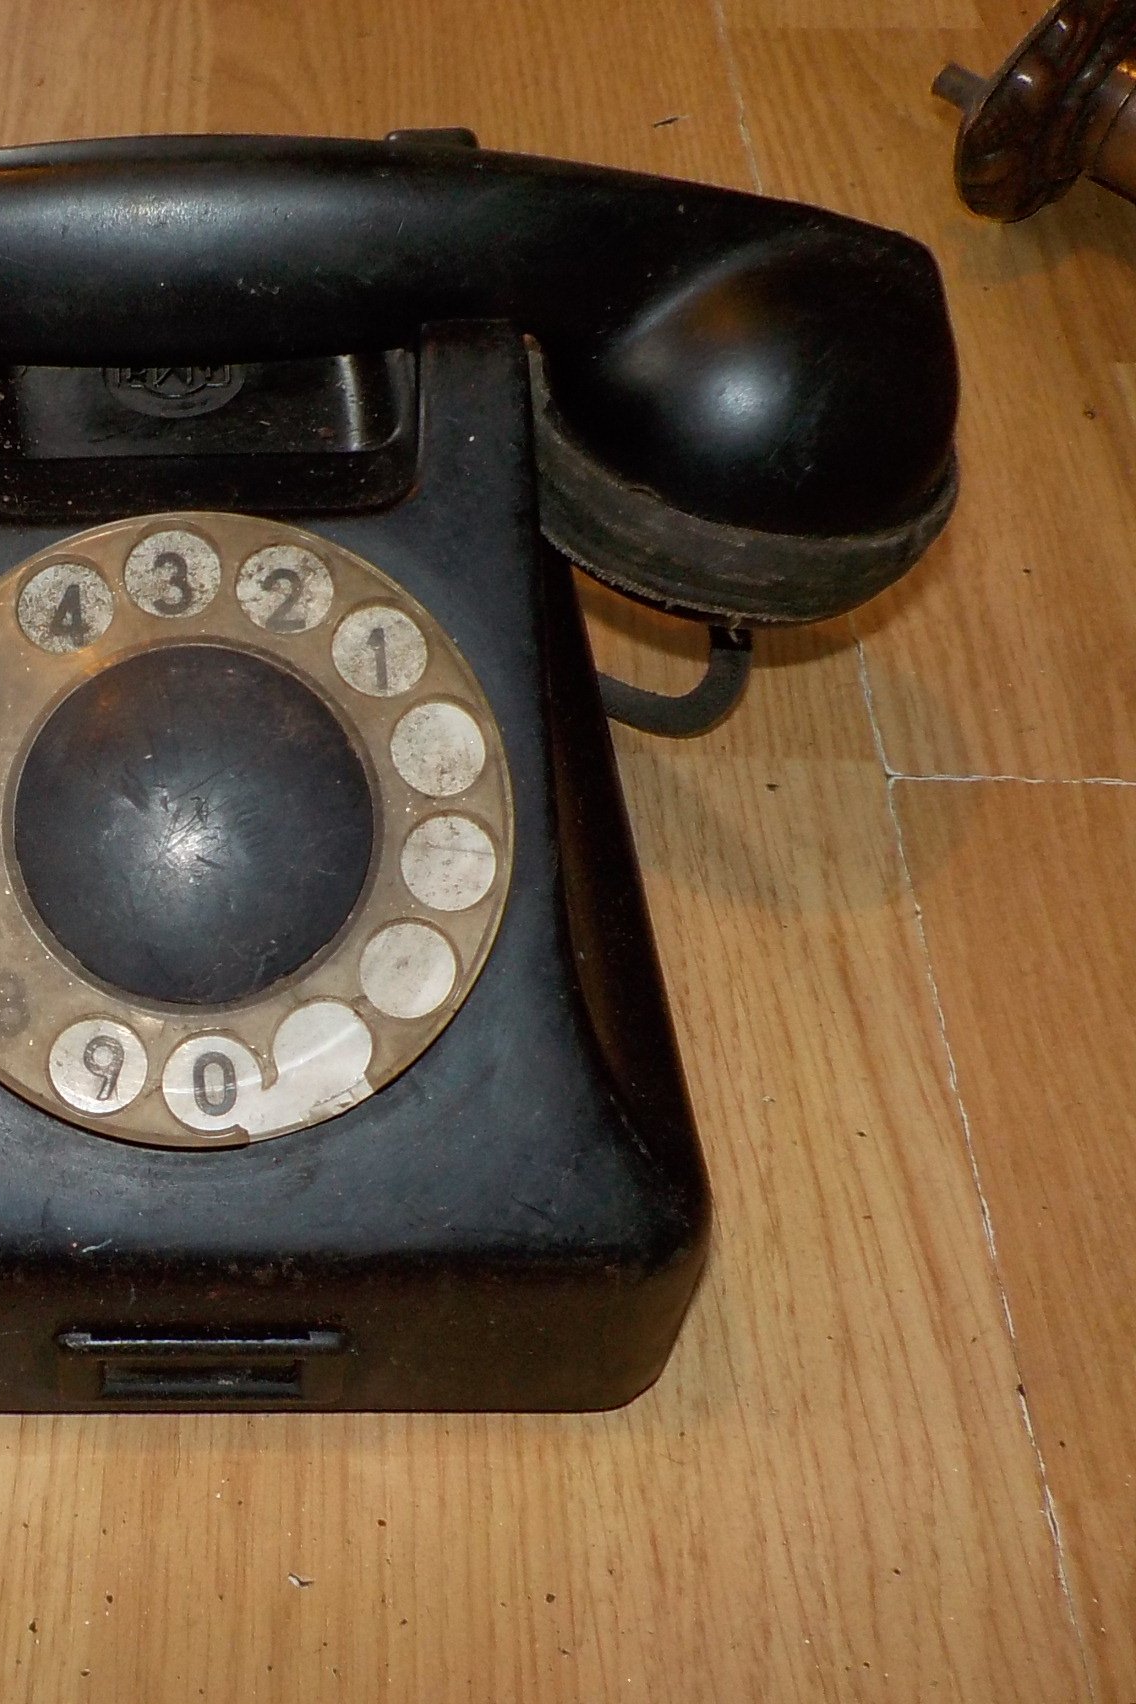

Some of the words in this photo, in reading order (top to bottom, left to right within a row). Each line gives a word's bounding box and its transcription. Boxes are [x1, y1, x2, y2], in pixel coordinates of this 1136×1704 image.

[153, 552, 193, 615] 3
[261, 568, 306, 630] 2
[49, 584, 91, 648] 4
[366, 627, 389, 690] 1
[83, 1035, 125, 1101] 9
[192, 1051, 237, 1116] 0
